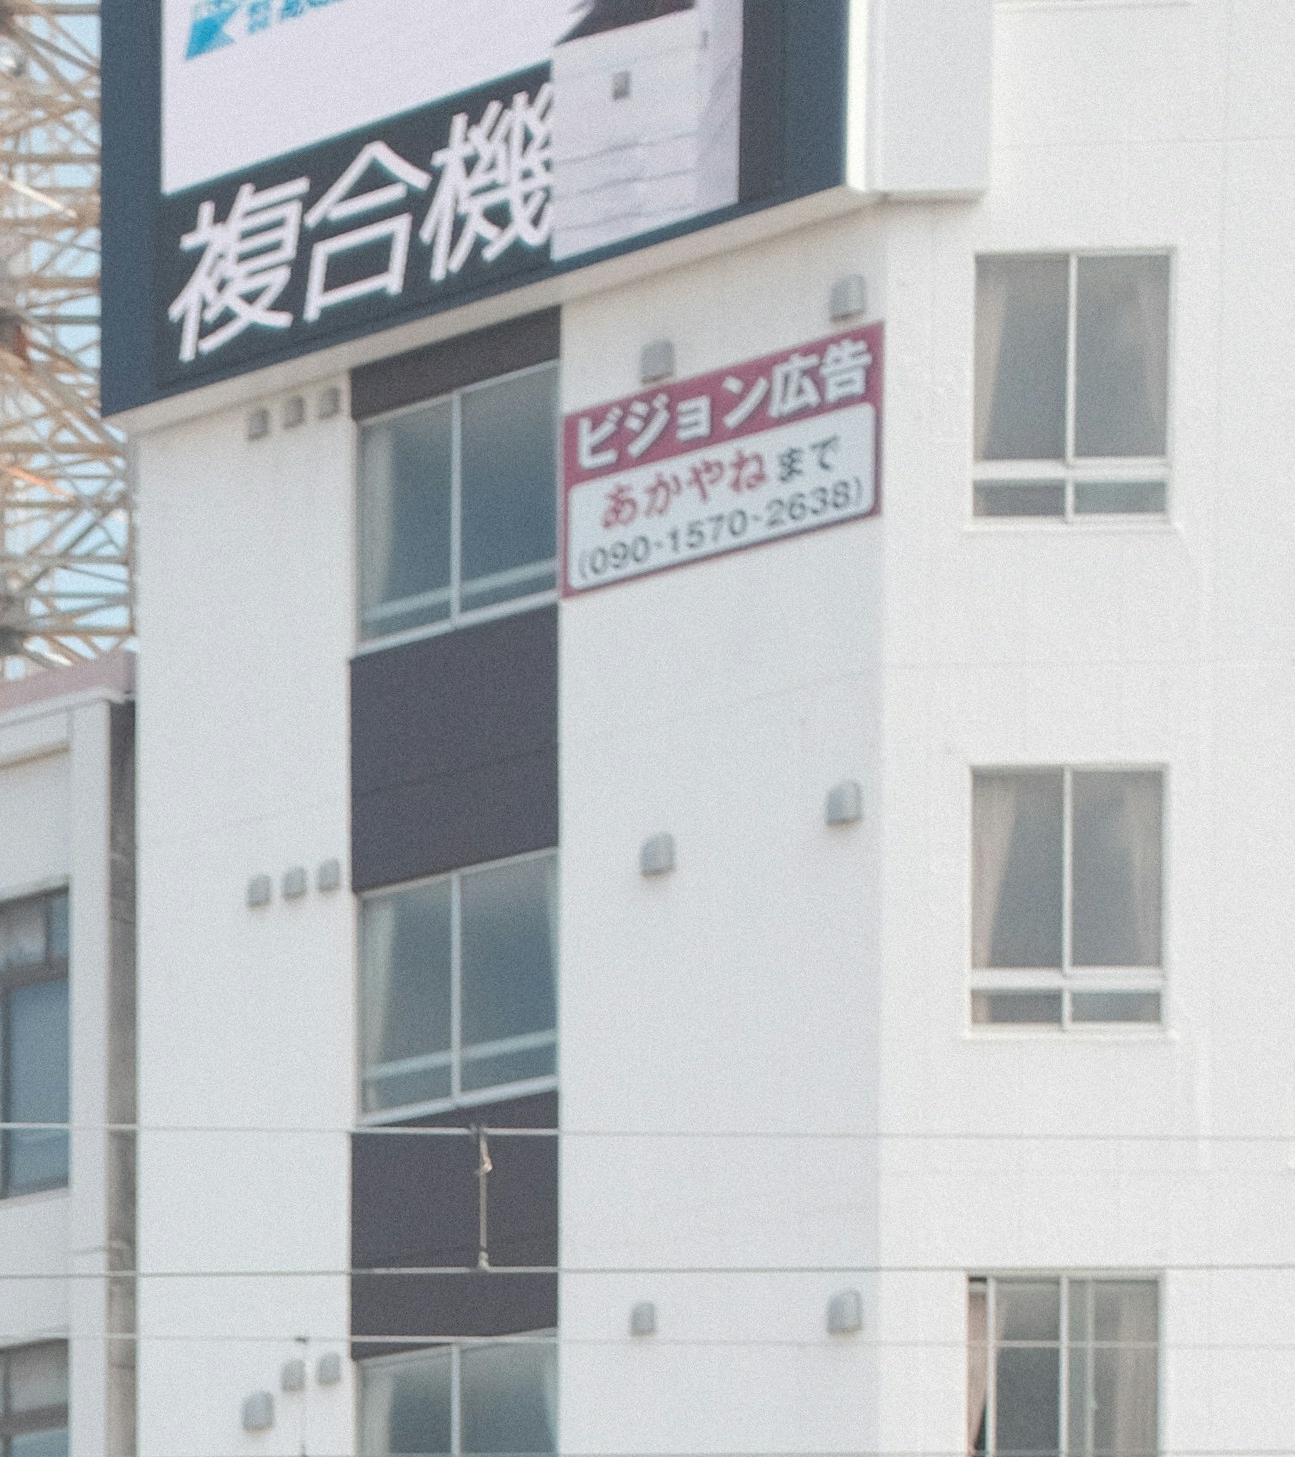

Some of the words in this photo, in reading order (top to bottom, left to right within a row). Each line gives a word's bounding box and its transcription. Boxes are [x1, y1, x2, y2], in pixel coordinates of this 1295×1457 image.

[168, 80, 552, 362] 複合機
[578, 338, 874, 471] ビジョン広告
[578, 476, 863, 580] (090-1570-2638)
